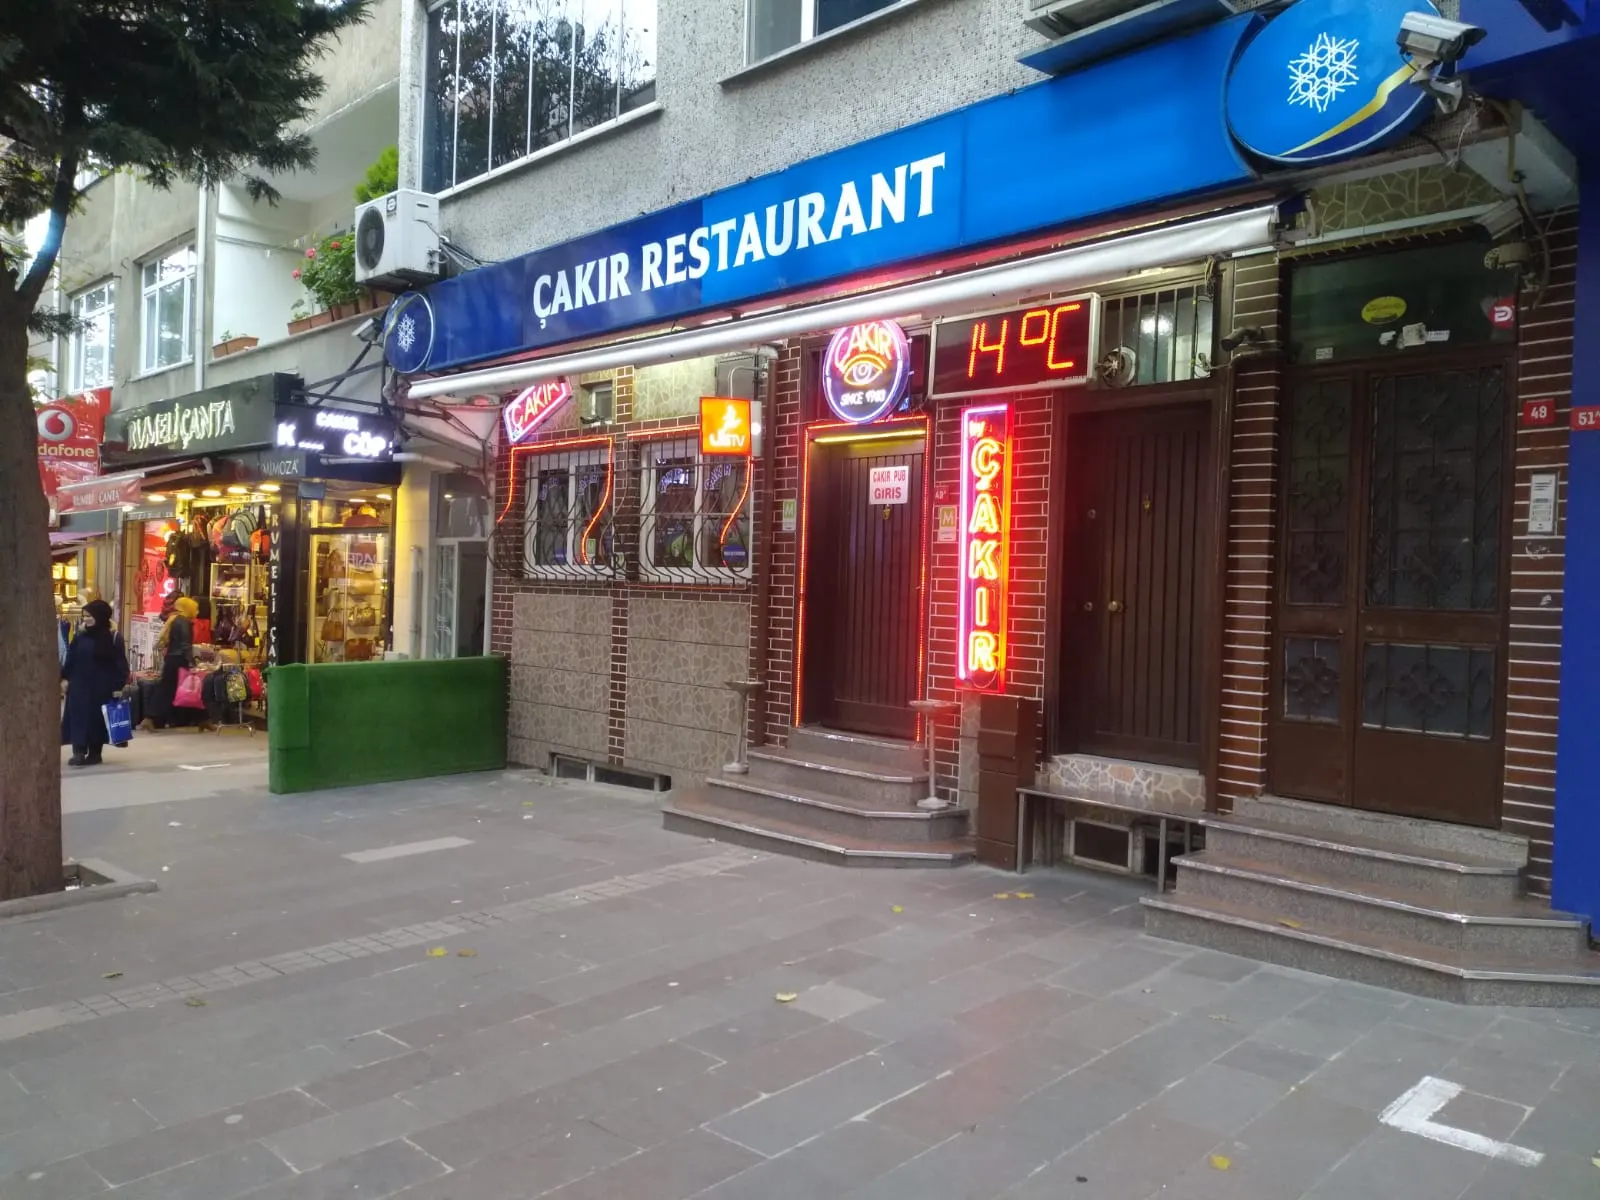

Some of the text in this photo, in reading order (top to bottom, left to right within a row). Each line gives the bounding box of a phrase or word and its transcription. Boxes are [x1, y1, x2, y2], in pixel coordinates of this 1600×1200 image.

[533, 152, 946, 329] ÇAKIR RESTAURANT
[968, 319, 1008, 378] 14
[839, 391, 864, 406] SINCE
[180, 400, 235, 449] ÇANTA
[38, 443, 95, 457] dafone
[894, 469, 906, 481] PUB
